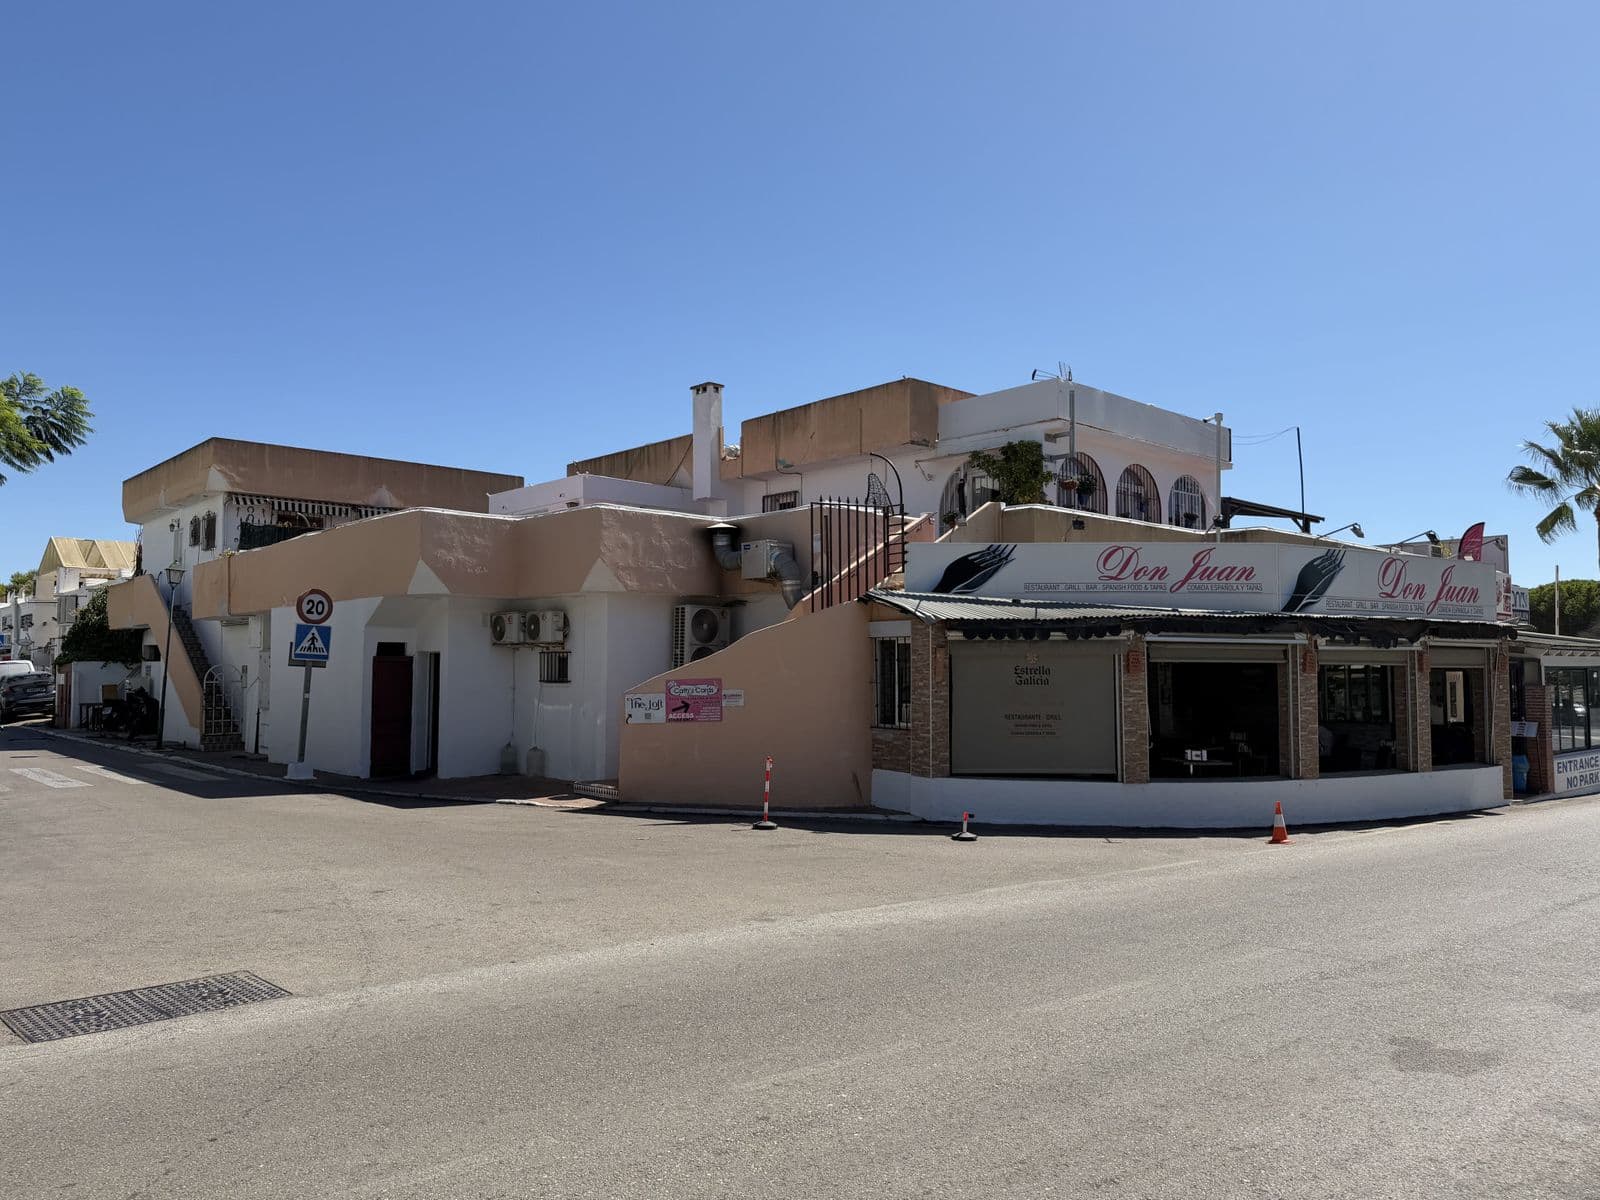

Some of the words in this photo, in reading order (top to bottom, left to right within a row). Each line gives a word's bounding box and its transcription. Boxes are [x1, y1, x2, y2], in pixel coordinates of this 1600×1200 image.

[1097, 545, 1168, 581] Don
[1169, 546, 1256, 594] Juan
[1023, 583, 1060, 591] RESTAURANT
[1064, 583, 1080, 591] GRILL
[1086, 583, 1098, 591] BAR
[1102, 583, 1126, 591] SPANISH
[1127, 583, 1143, 591] FOOD
[1149, 583, 1167, 591] TAPAS
[1378, 556, 1427, 600] Don
[1426, 564, 1480, 615] Juan
[306, 599, 325, 615] 20
[1014, 665, 1051, 675] Estrella
[1015, 675, 1049, 685] Galicia
[627, 697, 646, 710] The
[646, 698, 663, 711] Loft
[1556, 755, 1599, 774] ENTRANCE
[1567, 776, 1578, 789] NO
